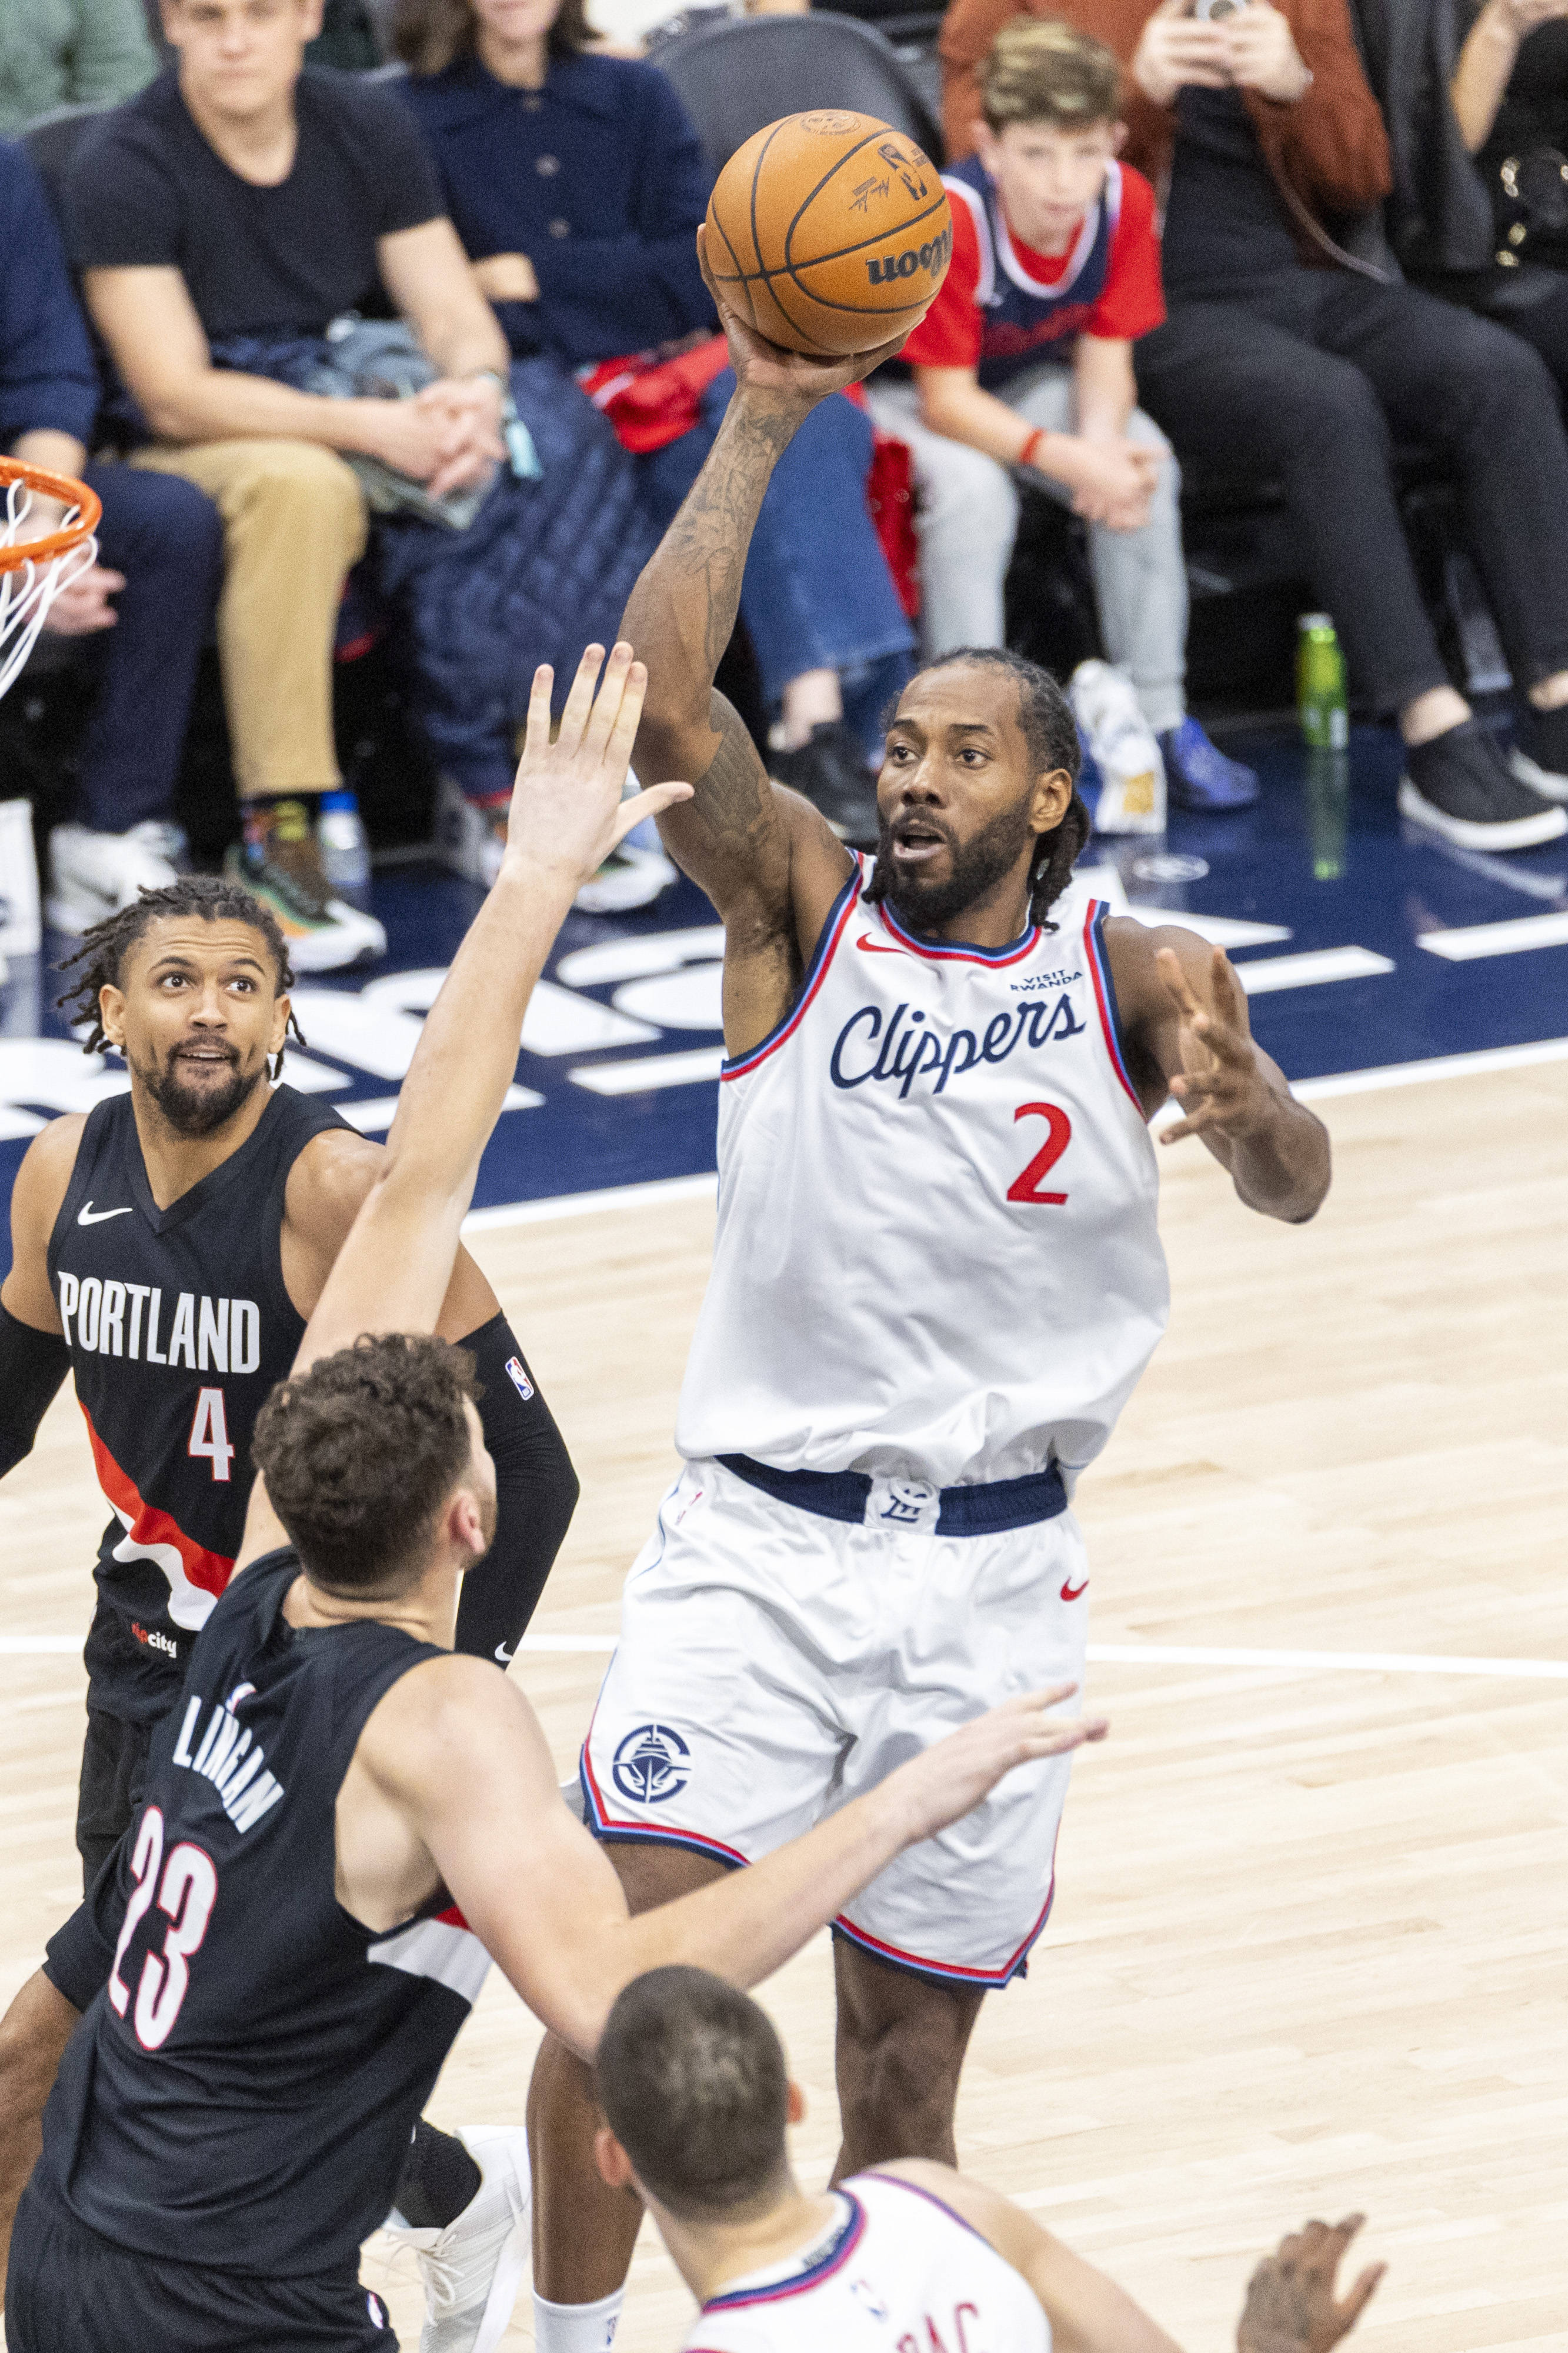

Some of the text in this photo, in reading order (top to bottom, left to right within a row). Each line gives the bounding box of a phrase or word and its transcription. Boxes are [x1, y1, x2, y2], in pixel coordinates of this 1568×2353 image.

[1010, 972, 1082, 991] RWANDA
[1023, 969, 1065, 984] VISIT
[830, 993, 1086, 1099] Clippers
[1006, 1102, 1072, 1205] 2
[58, 1271, 261, 1374] PORTLAND
[187, 1387, 235, 1482] 4
[108, 1805, 218, 2051] 23
